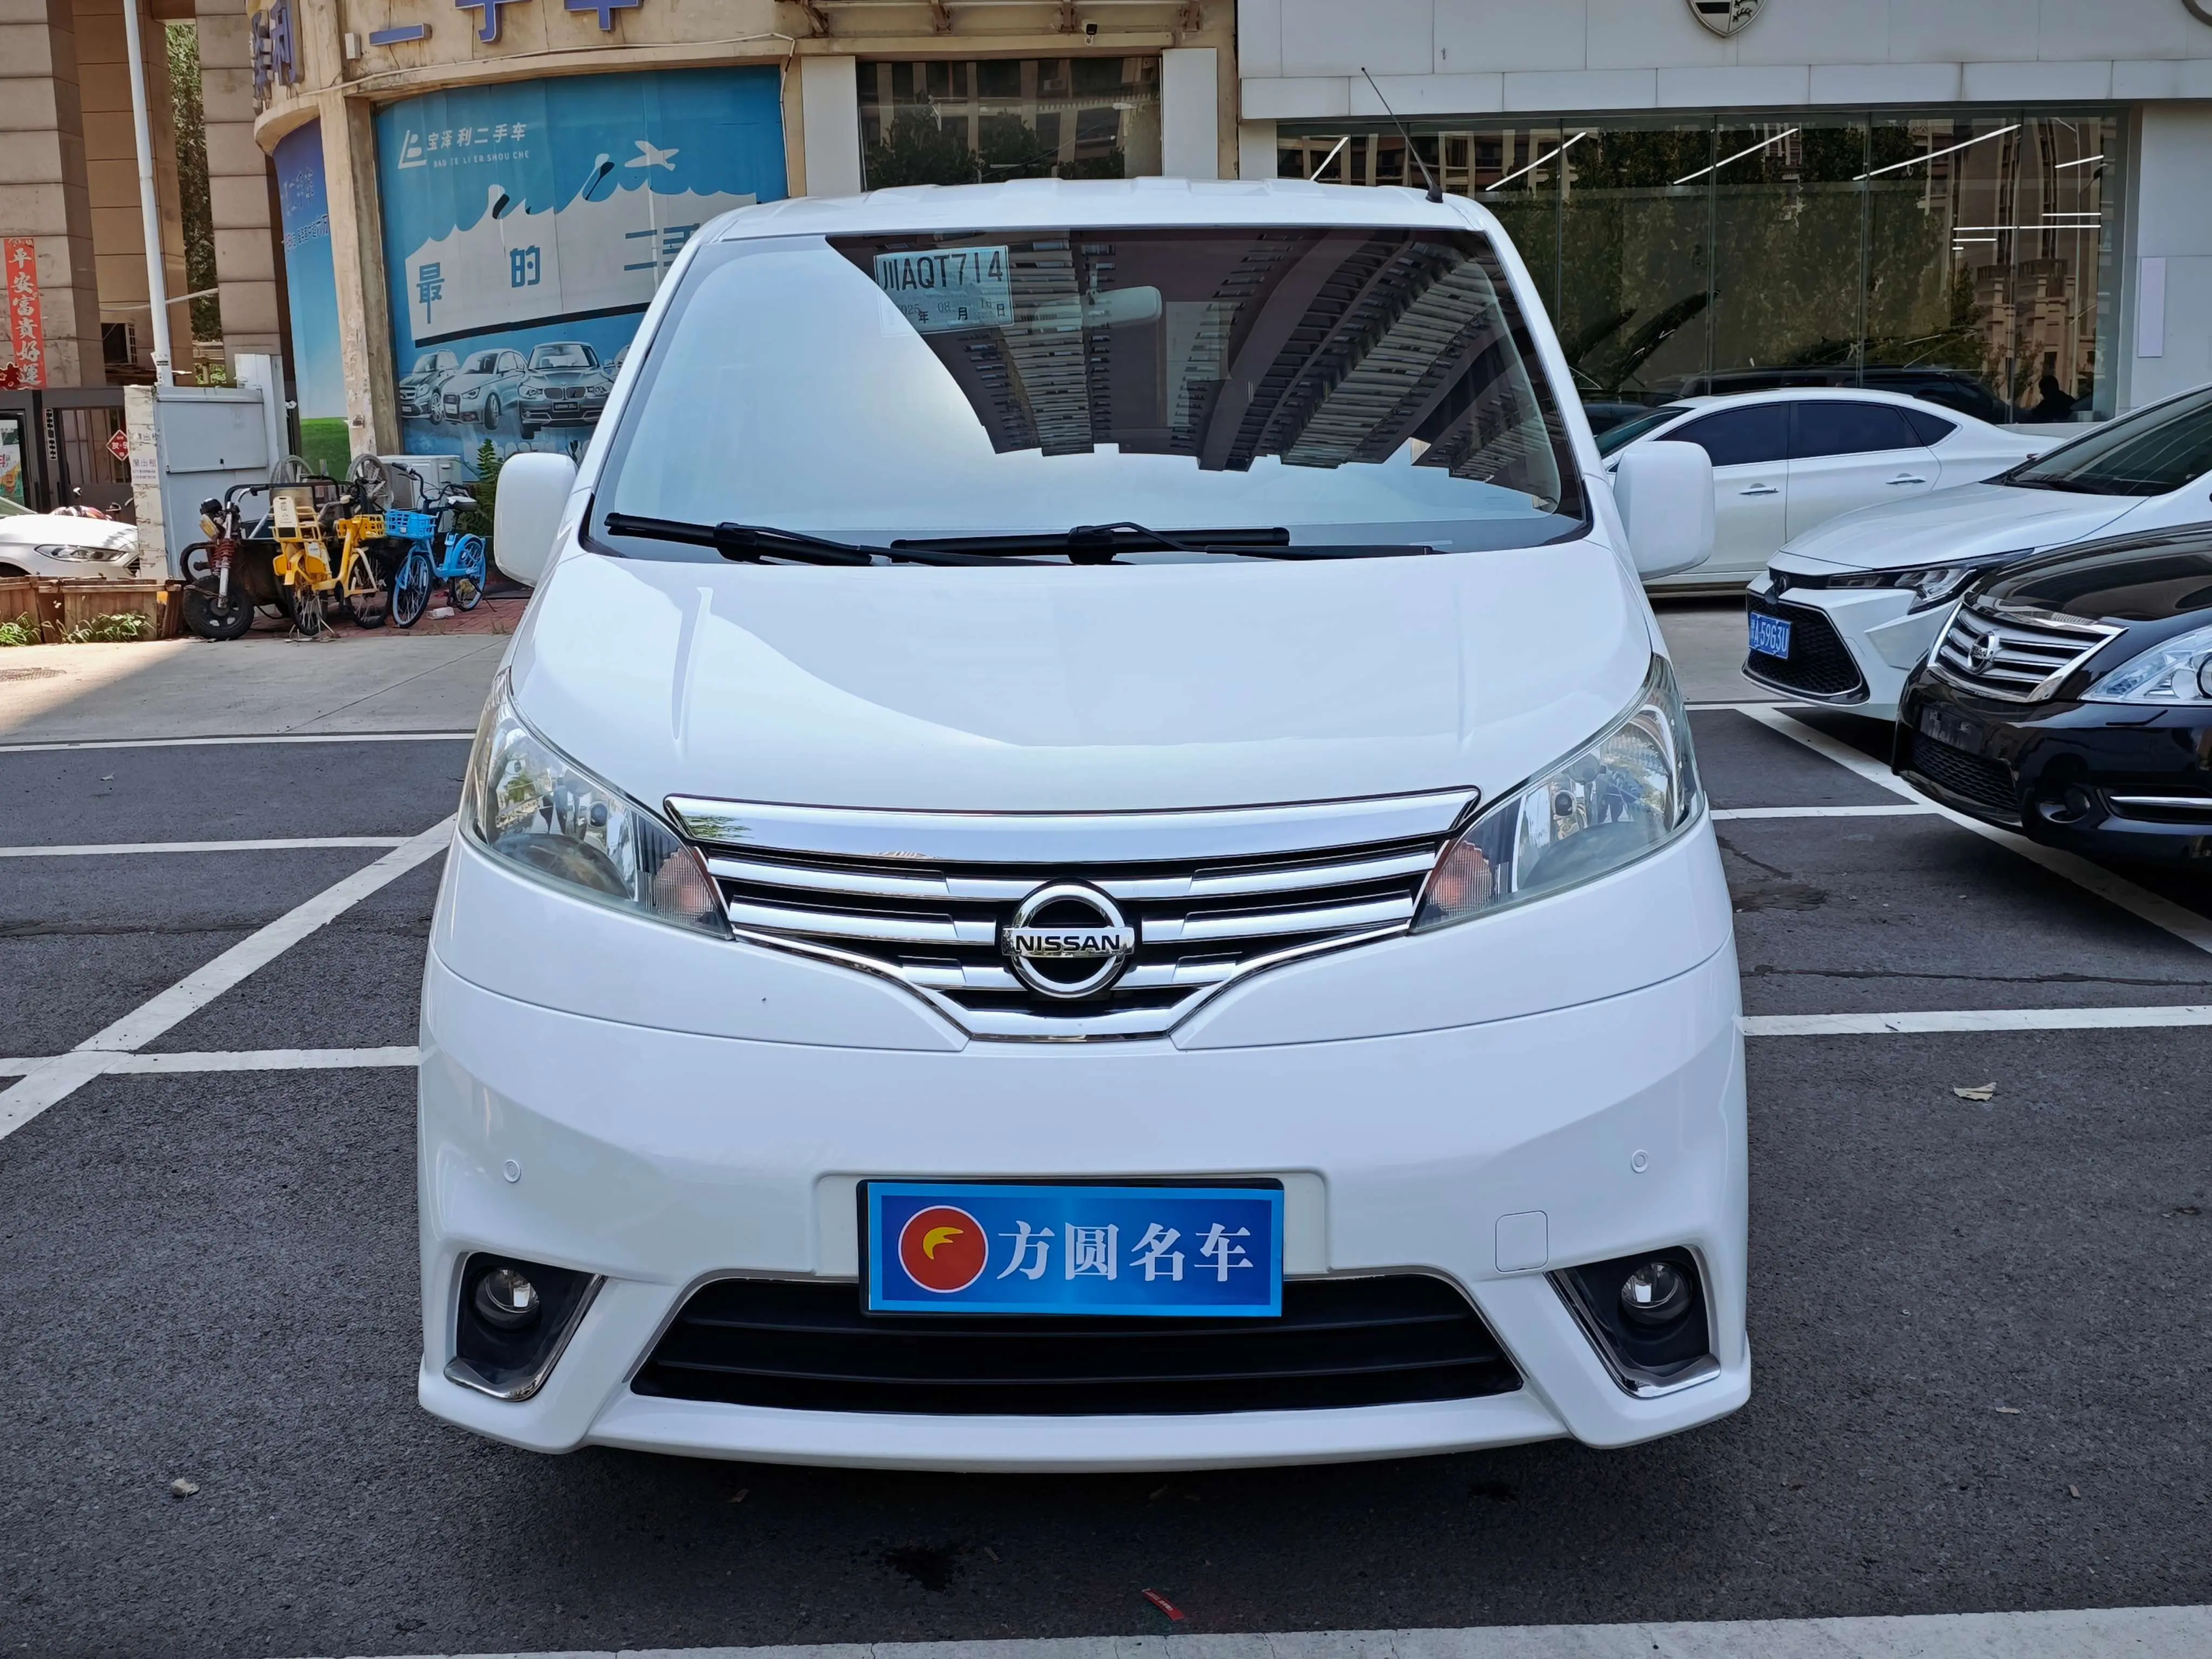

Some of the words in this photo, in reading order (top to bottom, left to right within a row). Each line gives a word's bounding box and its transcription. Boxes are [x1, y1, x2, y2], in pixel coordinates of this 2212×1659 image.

[427, 122, 527, 151] 宝泽利二手车
[434, 159, 447, 167] BAO
[474, 155, 484, 163] ER
[487, 152, 510, 162] SHOU
[513, 150, 530, 159] CHE
[416, 262, 444, 324] 最
[510, 245, 540, 288] 的
[882, 251, 1003, 291] 川AQT714
[919, 311, 929, 323] 年
[958, 307, 968, 320] 月
[997, 303, 1005, 318] 日
[1016, 934, 1120, 952] NISSAN
[996, 1220, 1253, 1282] 方圆名车
